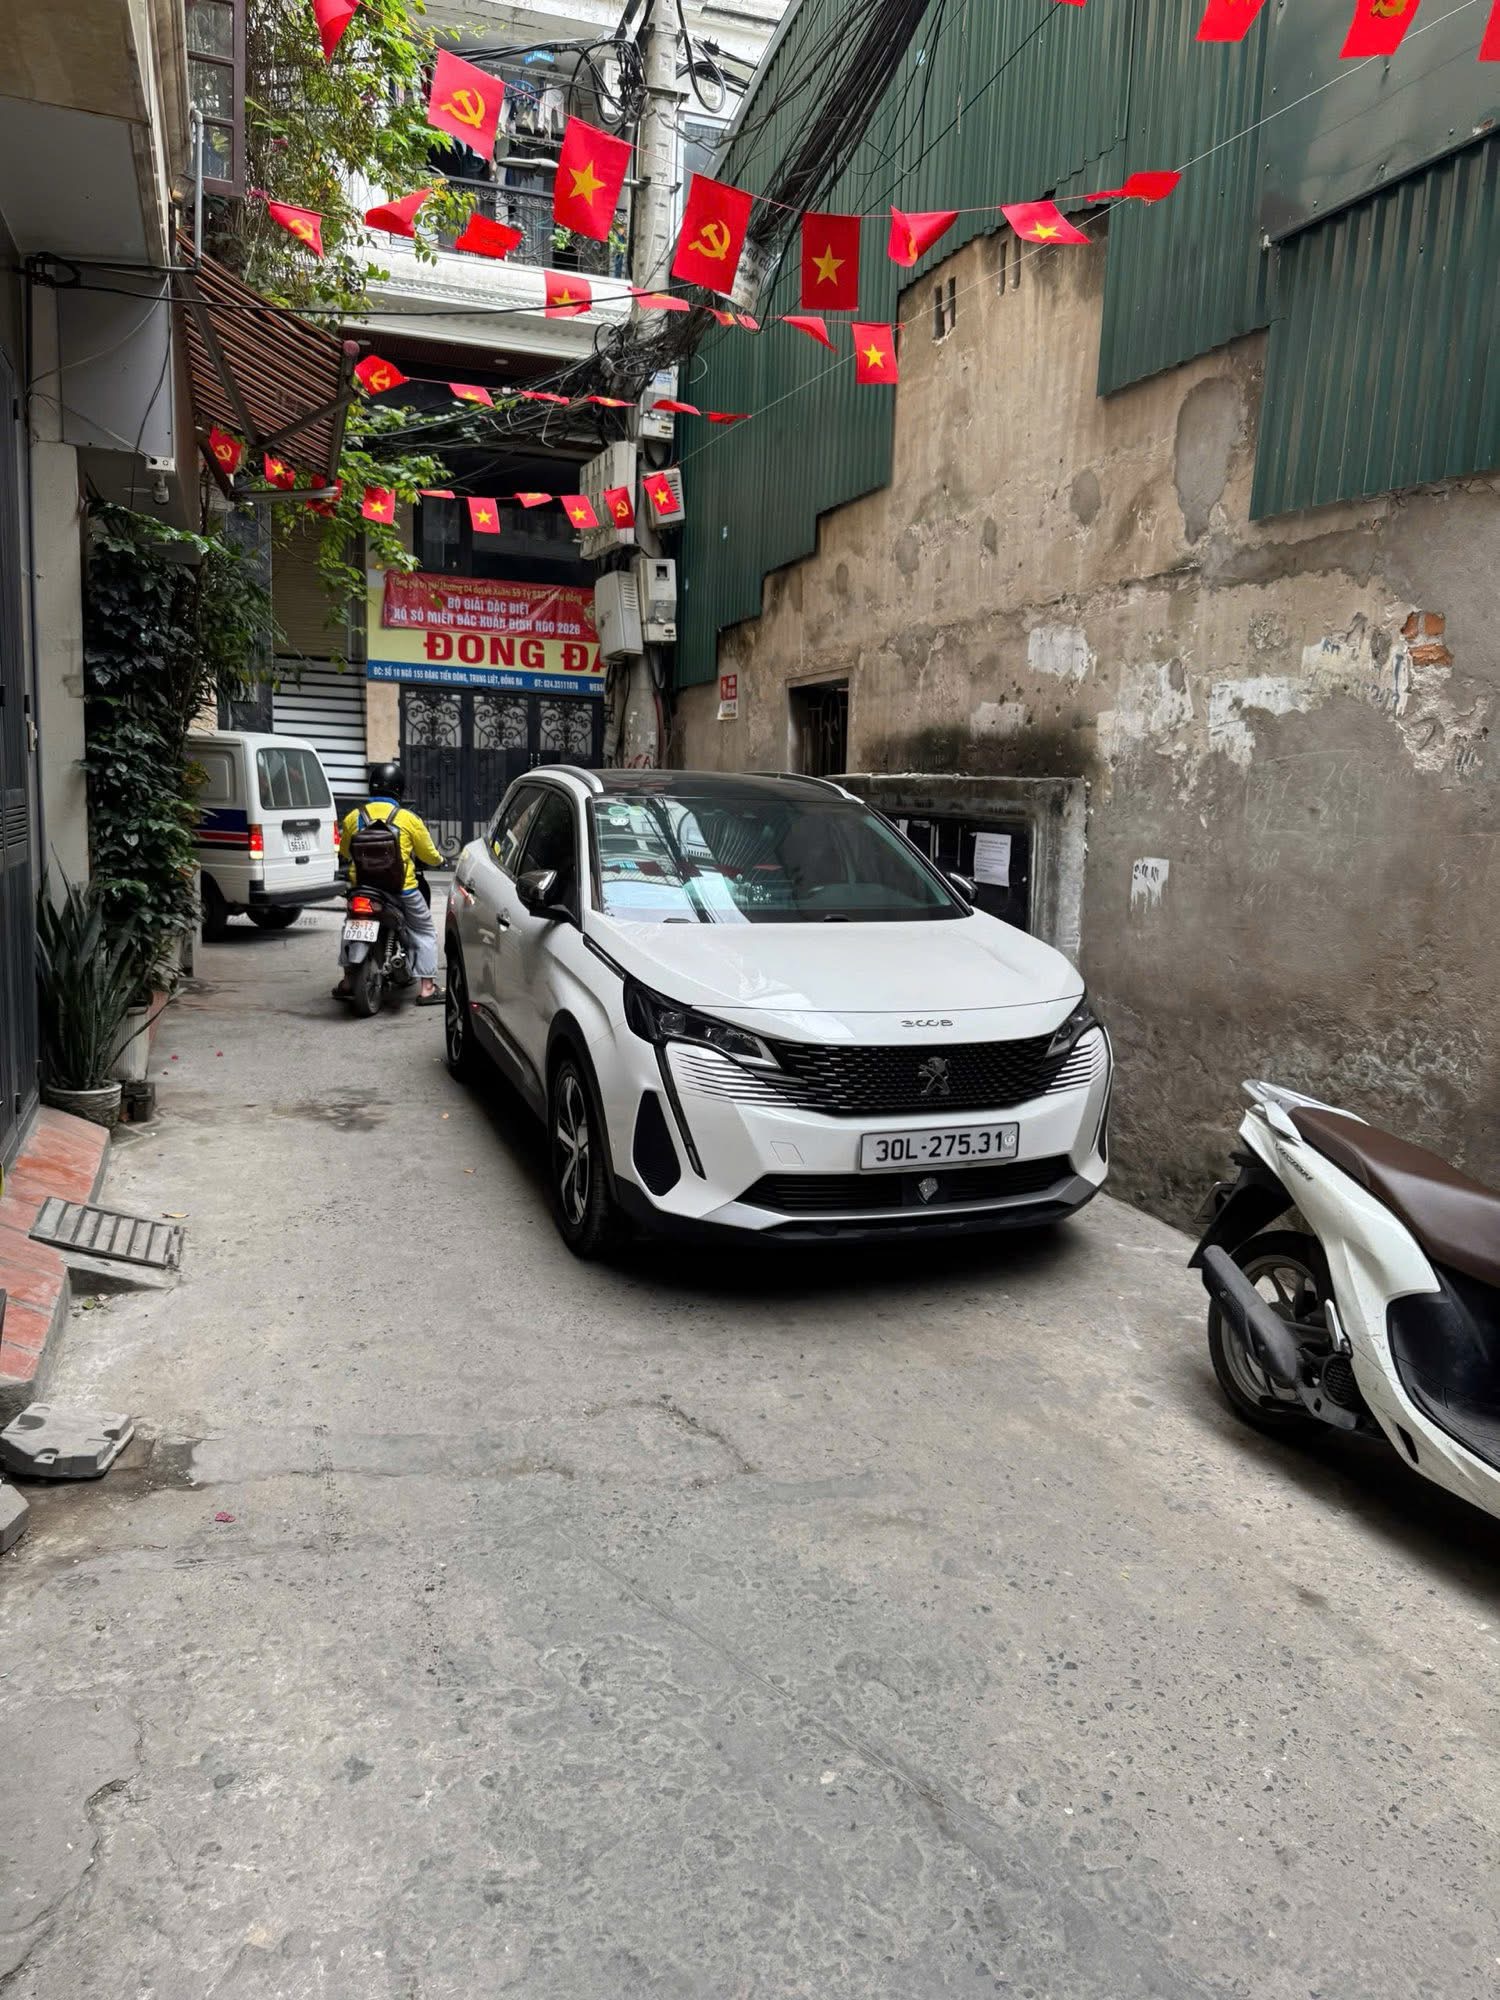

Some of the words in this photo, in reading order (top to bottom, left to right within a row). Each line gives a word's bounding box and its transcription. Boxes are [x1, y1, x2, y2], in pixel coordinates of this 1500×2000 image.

[447, 597, 461, 612] BỘ
[464, 596, 484, 612] GIẢI
[410, 606, 424, 622] SỐ
[427, 607, 454, 625] MIỀN
[456, 611, 477, 627] BẮC
[479, 614, 506, 629] XUÂN
[535, 620, 555, 635] NGỌ
[557, 622, 580, 635] 2026
[876, 1130, 1004, 1162] 30L-275.31
